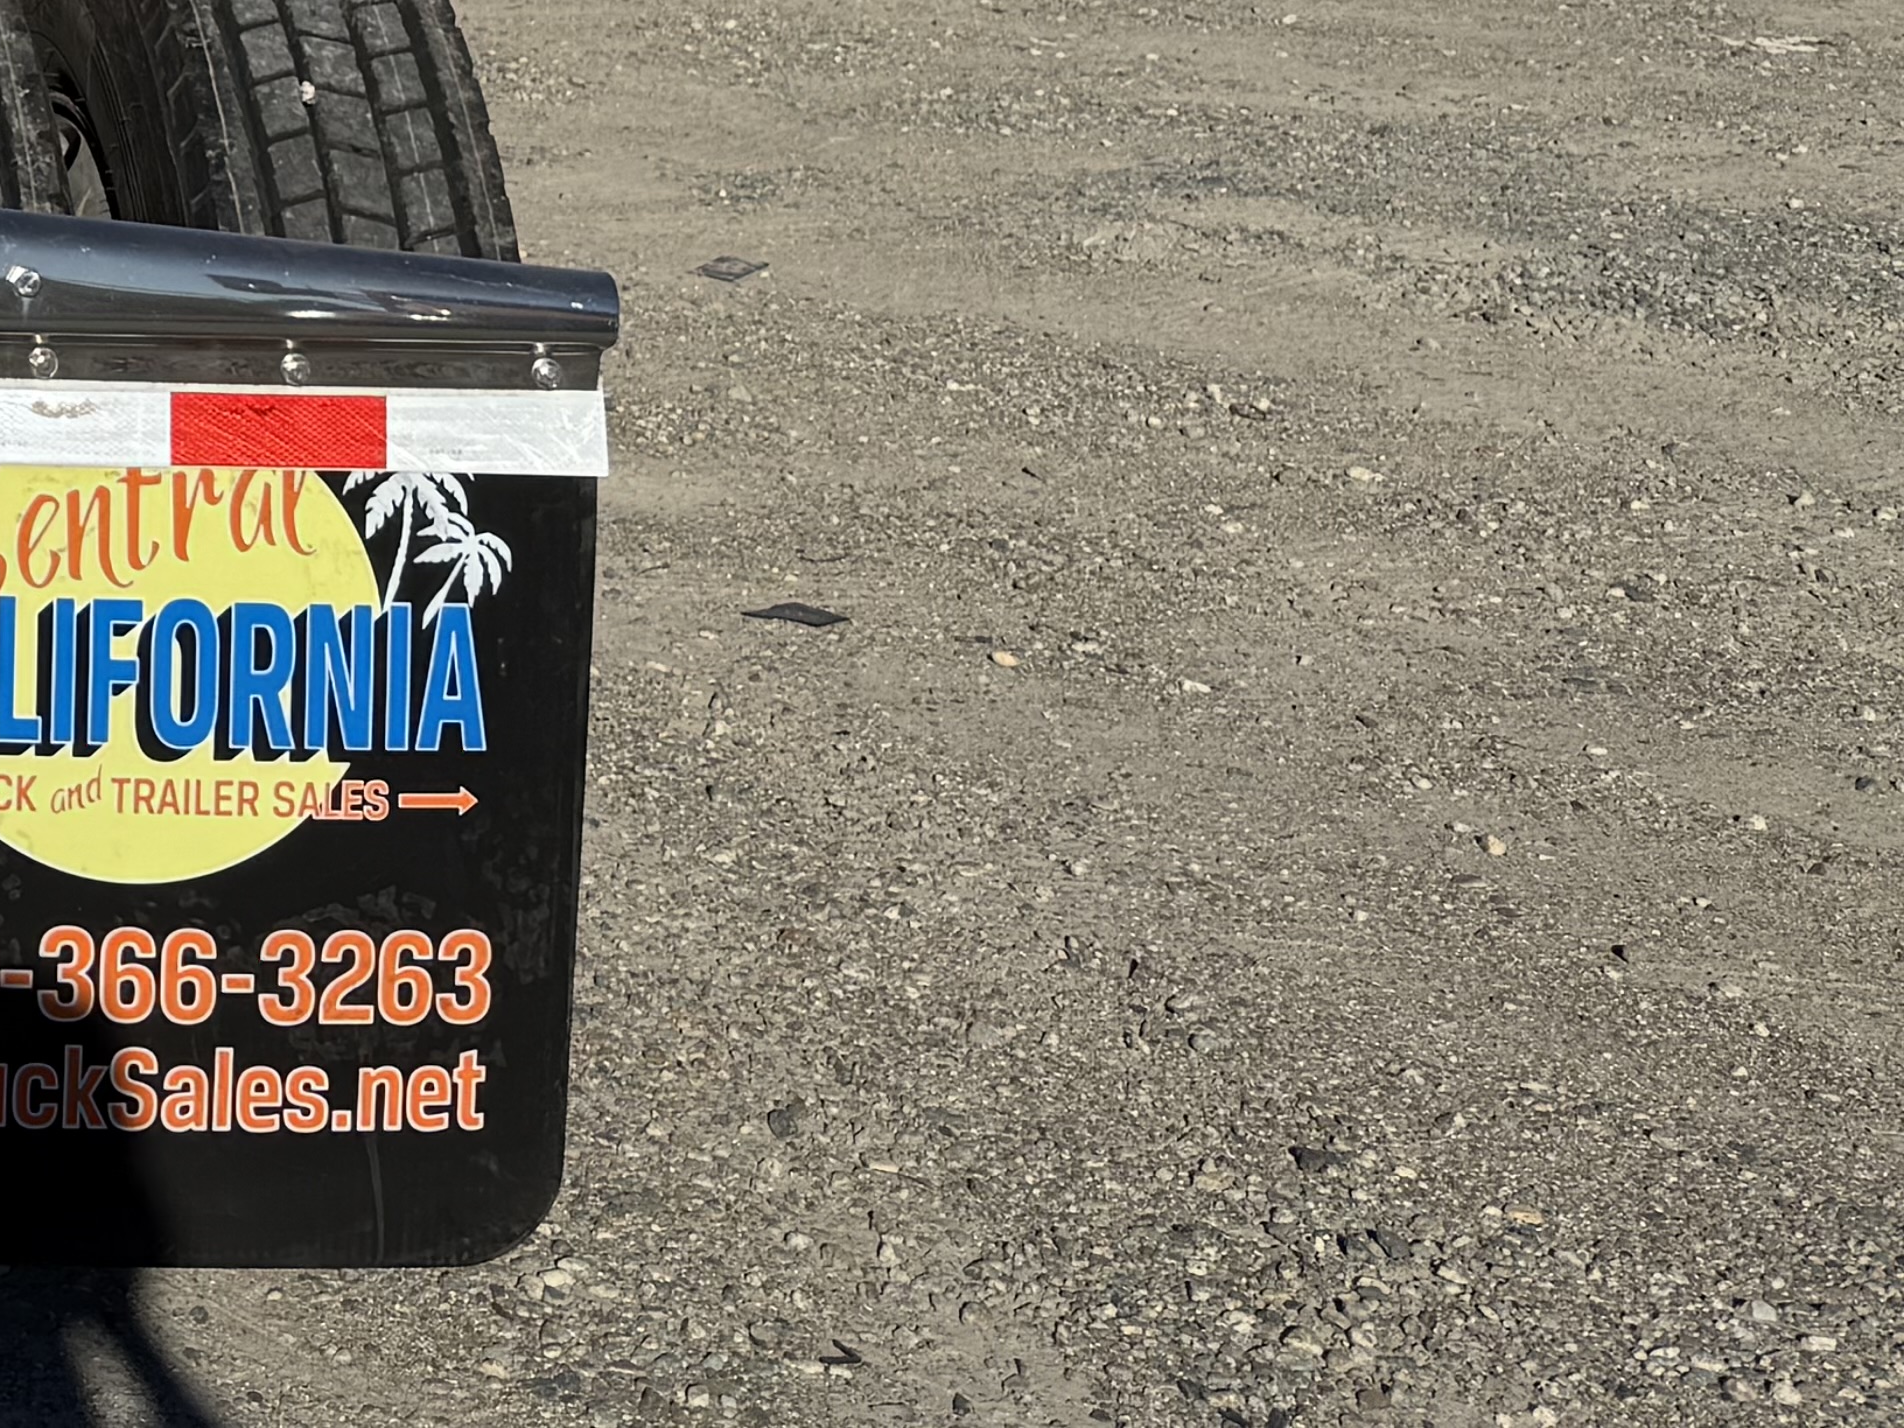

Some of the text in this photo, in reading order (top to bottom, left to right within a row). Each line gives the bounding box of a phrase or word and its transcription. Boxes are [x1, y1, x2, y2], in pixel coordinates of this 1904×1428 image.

[50, 765, 102, 813] and
[111, 777, 259, 817] TRAILER
[272, 780, 390, 820] SALES
